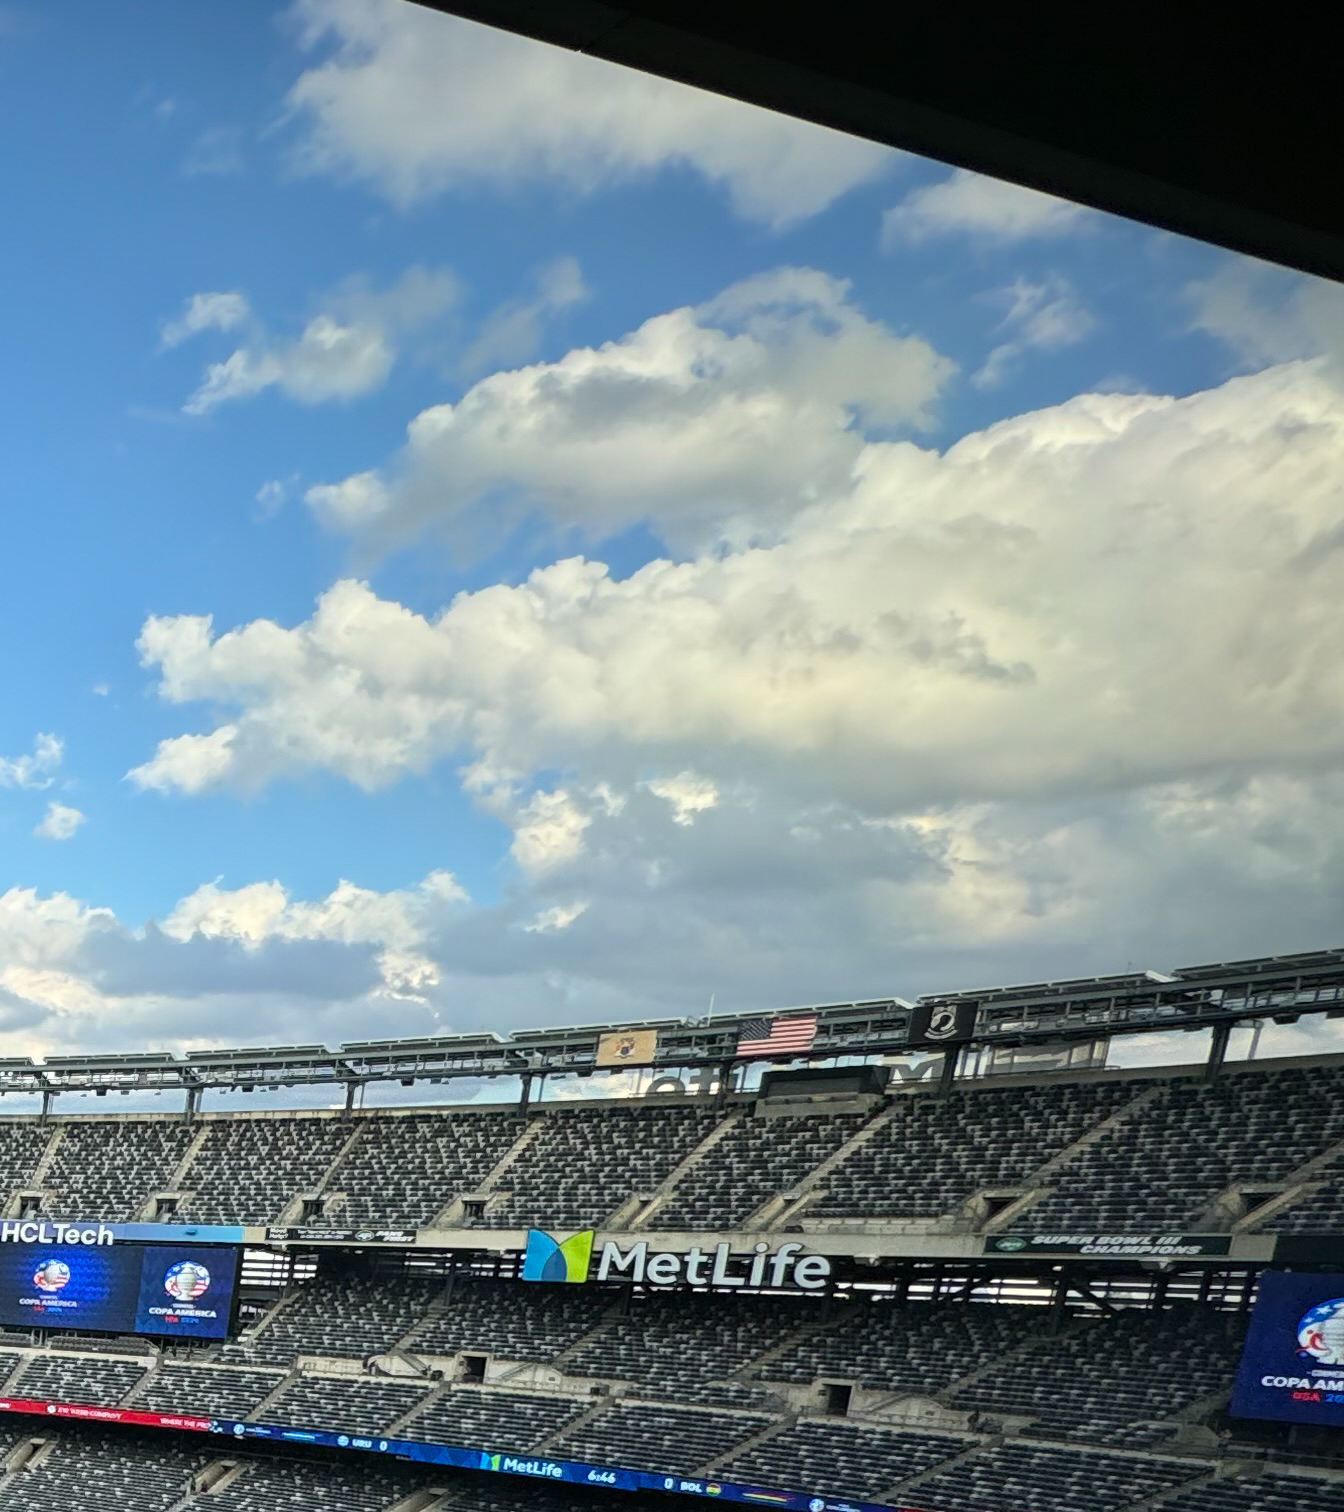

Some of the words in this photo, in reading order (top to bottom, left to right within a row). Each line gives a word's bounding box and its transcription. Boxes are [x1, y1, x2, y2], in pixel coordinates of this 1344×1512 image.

[1, 1222, 113, 1245] HCLTech
[1031, 1235, 1092, 1245] SUPER
[1094, 1236, 1153, 1245] BOWL
[1156, 1236, 1182, 1245] III
[1080, 1245, 1203, 1255] CHAMPIONS
[597, 1241, 831, 1289] MetLife
[1261, 1376, 1310, 1389] COPA
[504, 1458, 563, 1478] MetLife
[681, 1481, 702, 1493] BOL
